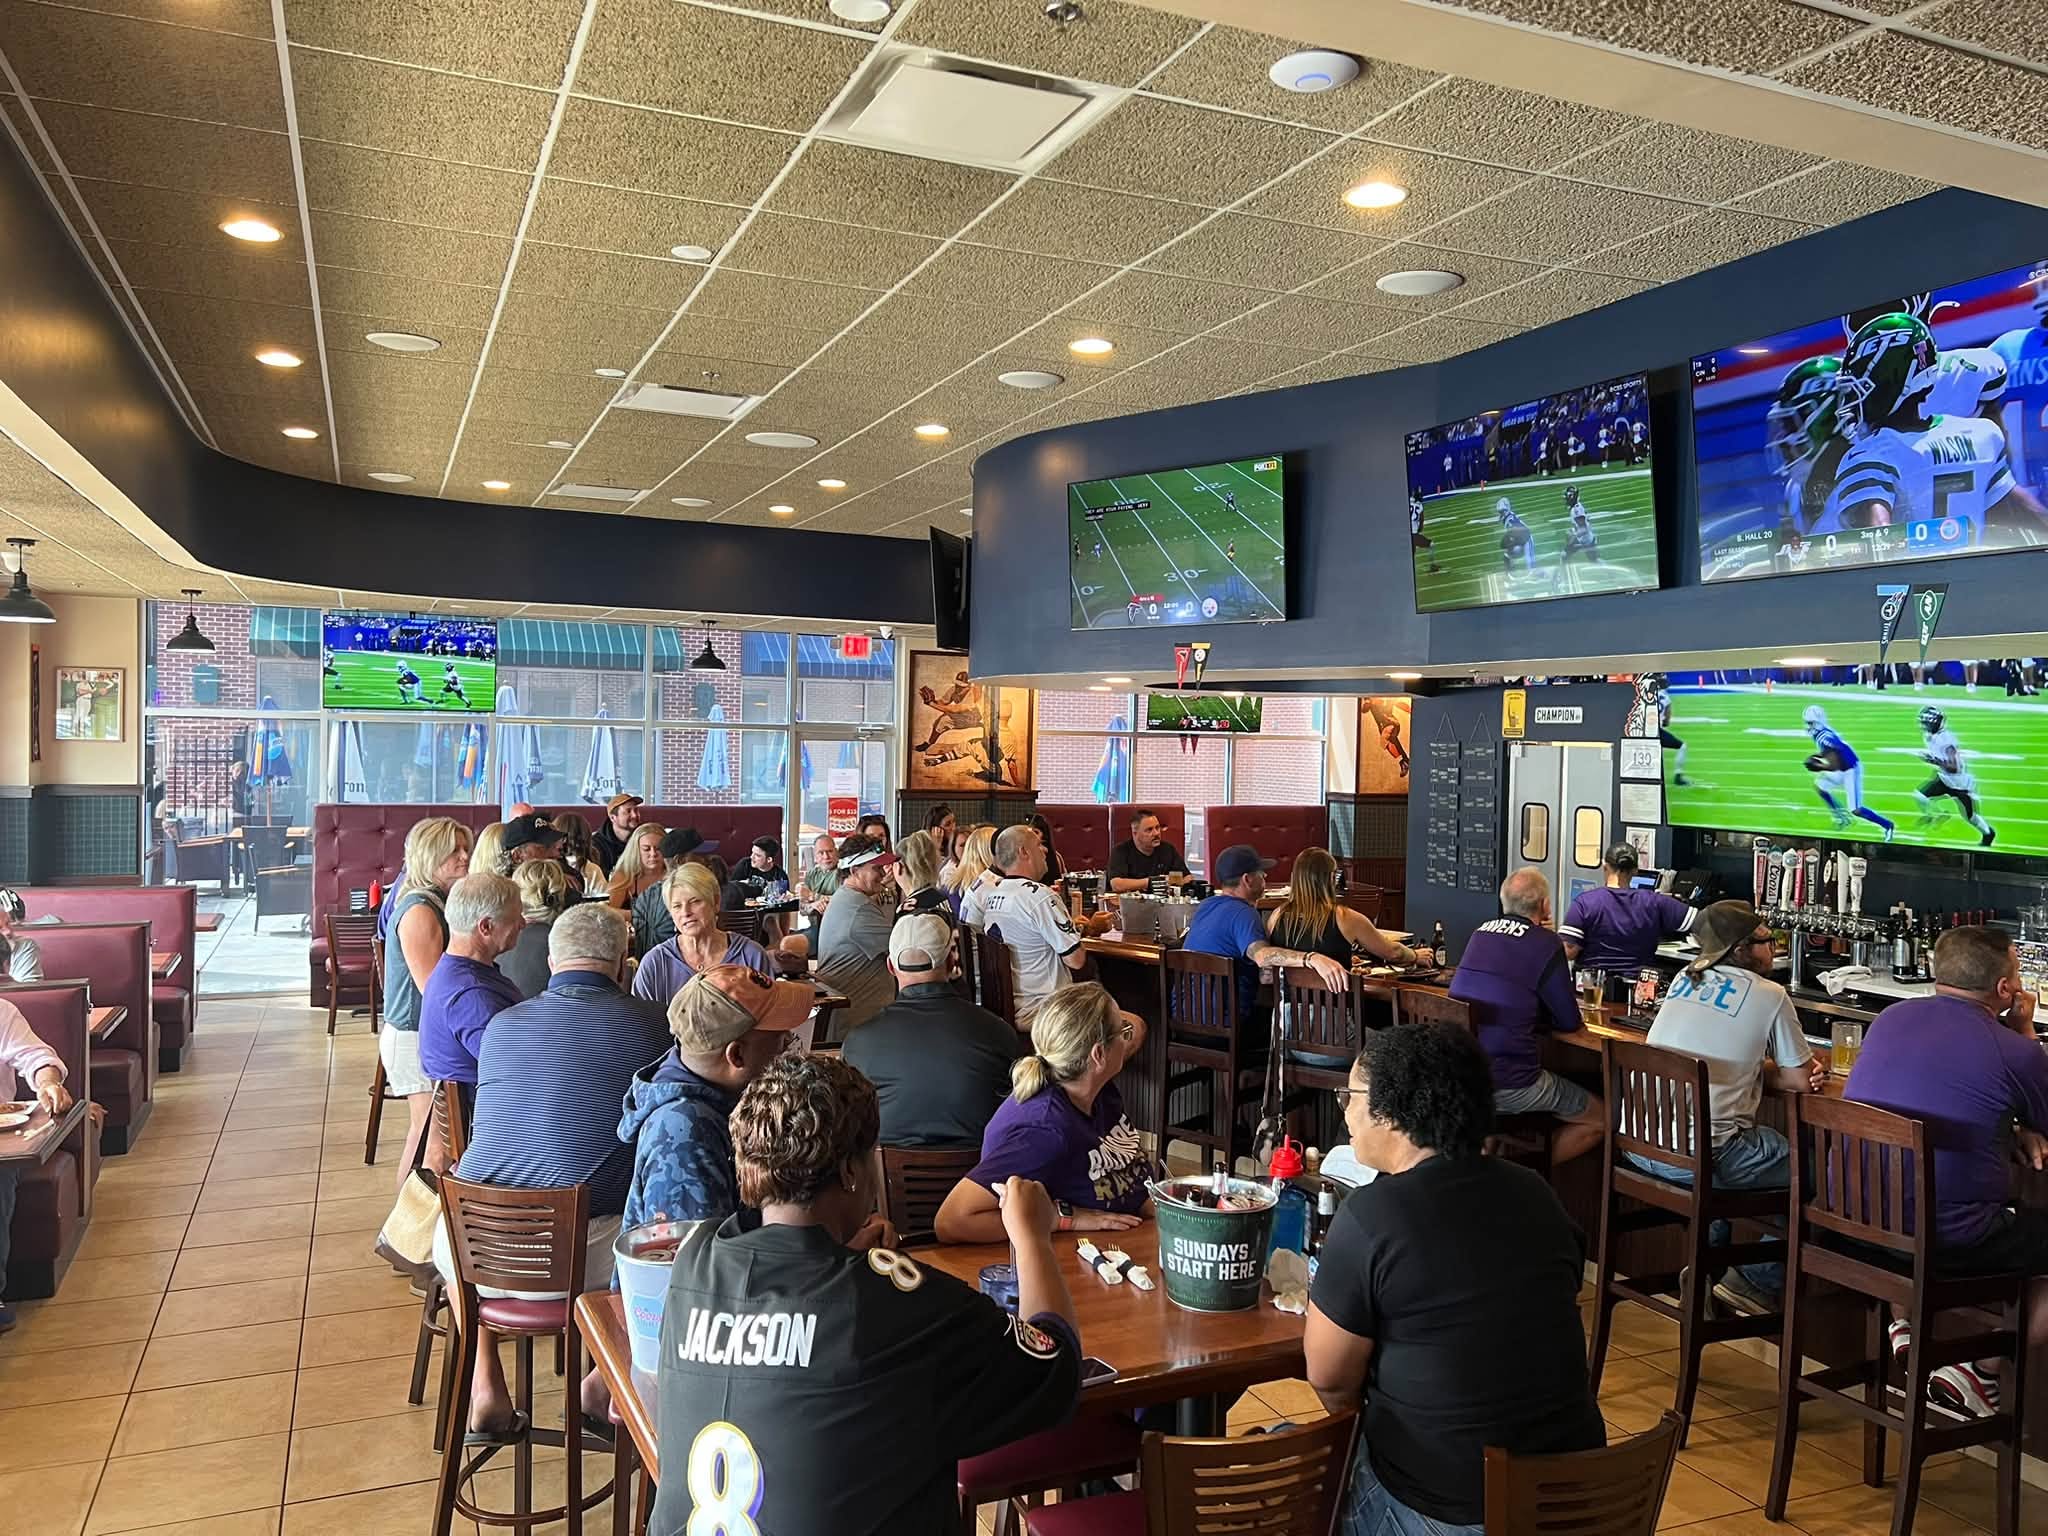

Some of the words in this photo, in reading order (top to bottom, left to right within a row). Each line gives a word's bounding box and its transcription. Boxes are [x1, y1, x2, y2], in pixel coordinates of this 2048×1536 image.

[1860, 330, 1912, 358] JETS
[1622, 380, 1642, 390] SPORTS
[1930, 434, 1977, 465] WILSON
[1744, 532, 1762, 541] HALL
[1763, 530, 1773, 539] 20
[1825, 534, 1837, 552] 0
[1915, 524, 1928, 542] 0
[1148, 603, 1158, 616] 0
[846, 637, 868, 657] EXIT
[1536, 708, 1576, 722] CHAMPION
[1476, 918, 1530, 938] RAVENS
[1173, 1237, 1249, 1262] SUNDAYS
[868, 1247, 925, 1292] 8
[1167, 1252, 1214, 1281] START
[1218, 1260, 1257, 1281] HERE
[679, 1307, 817, 1368] JACKSON
